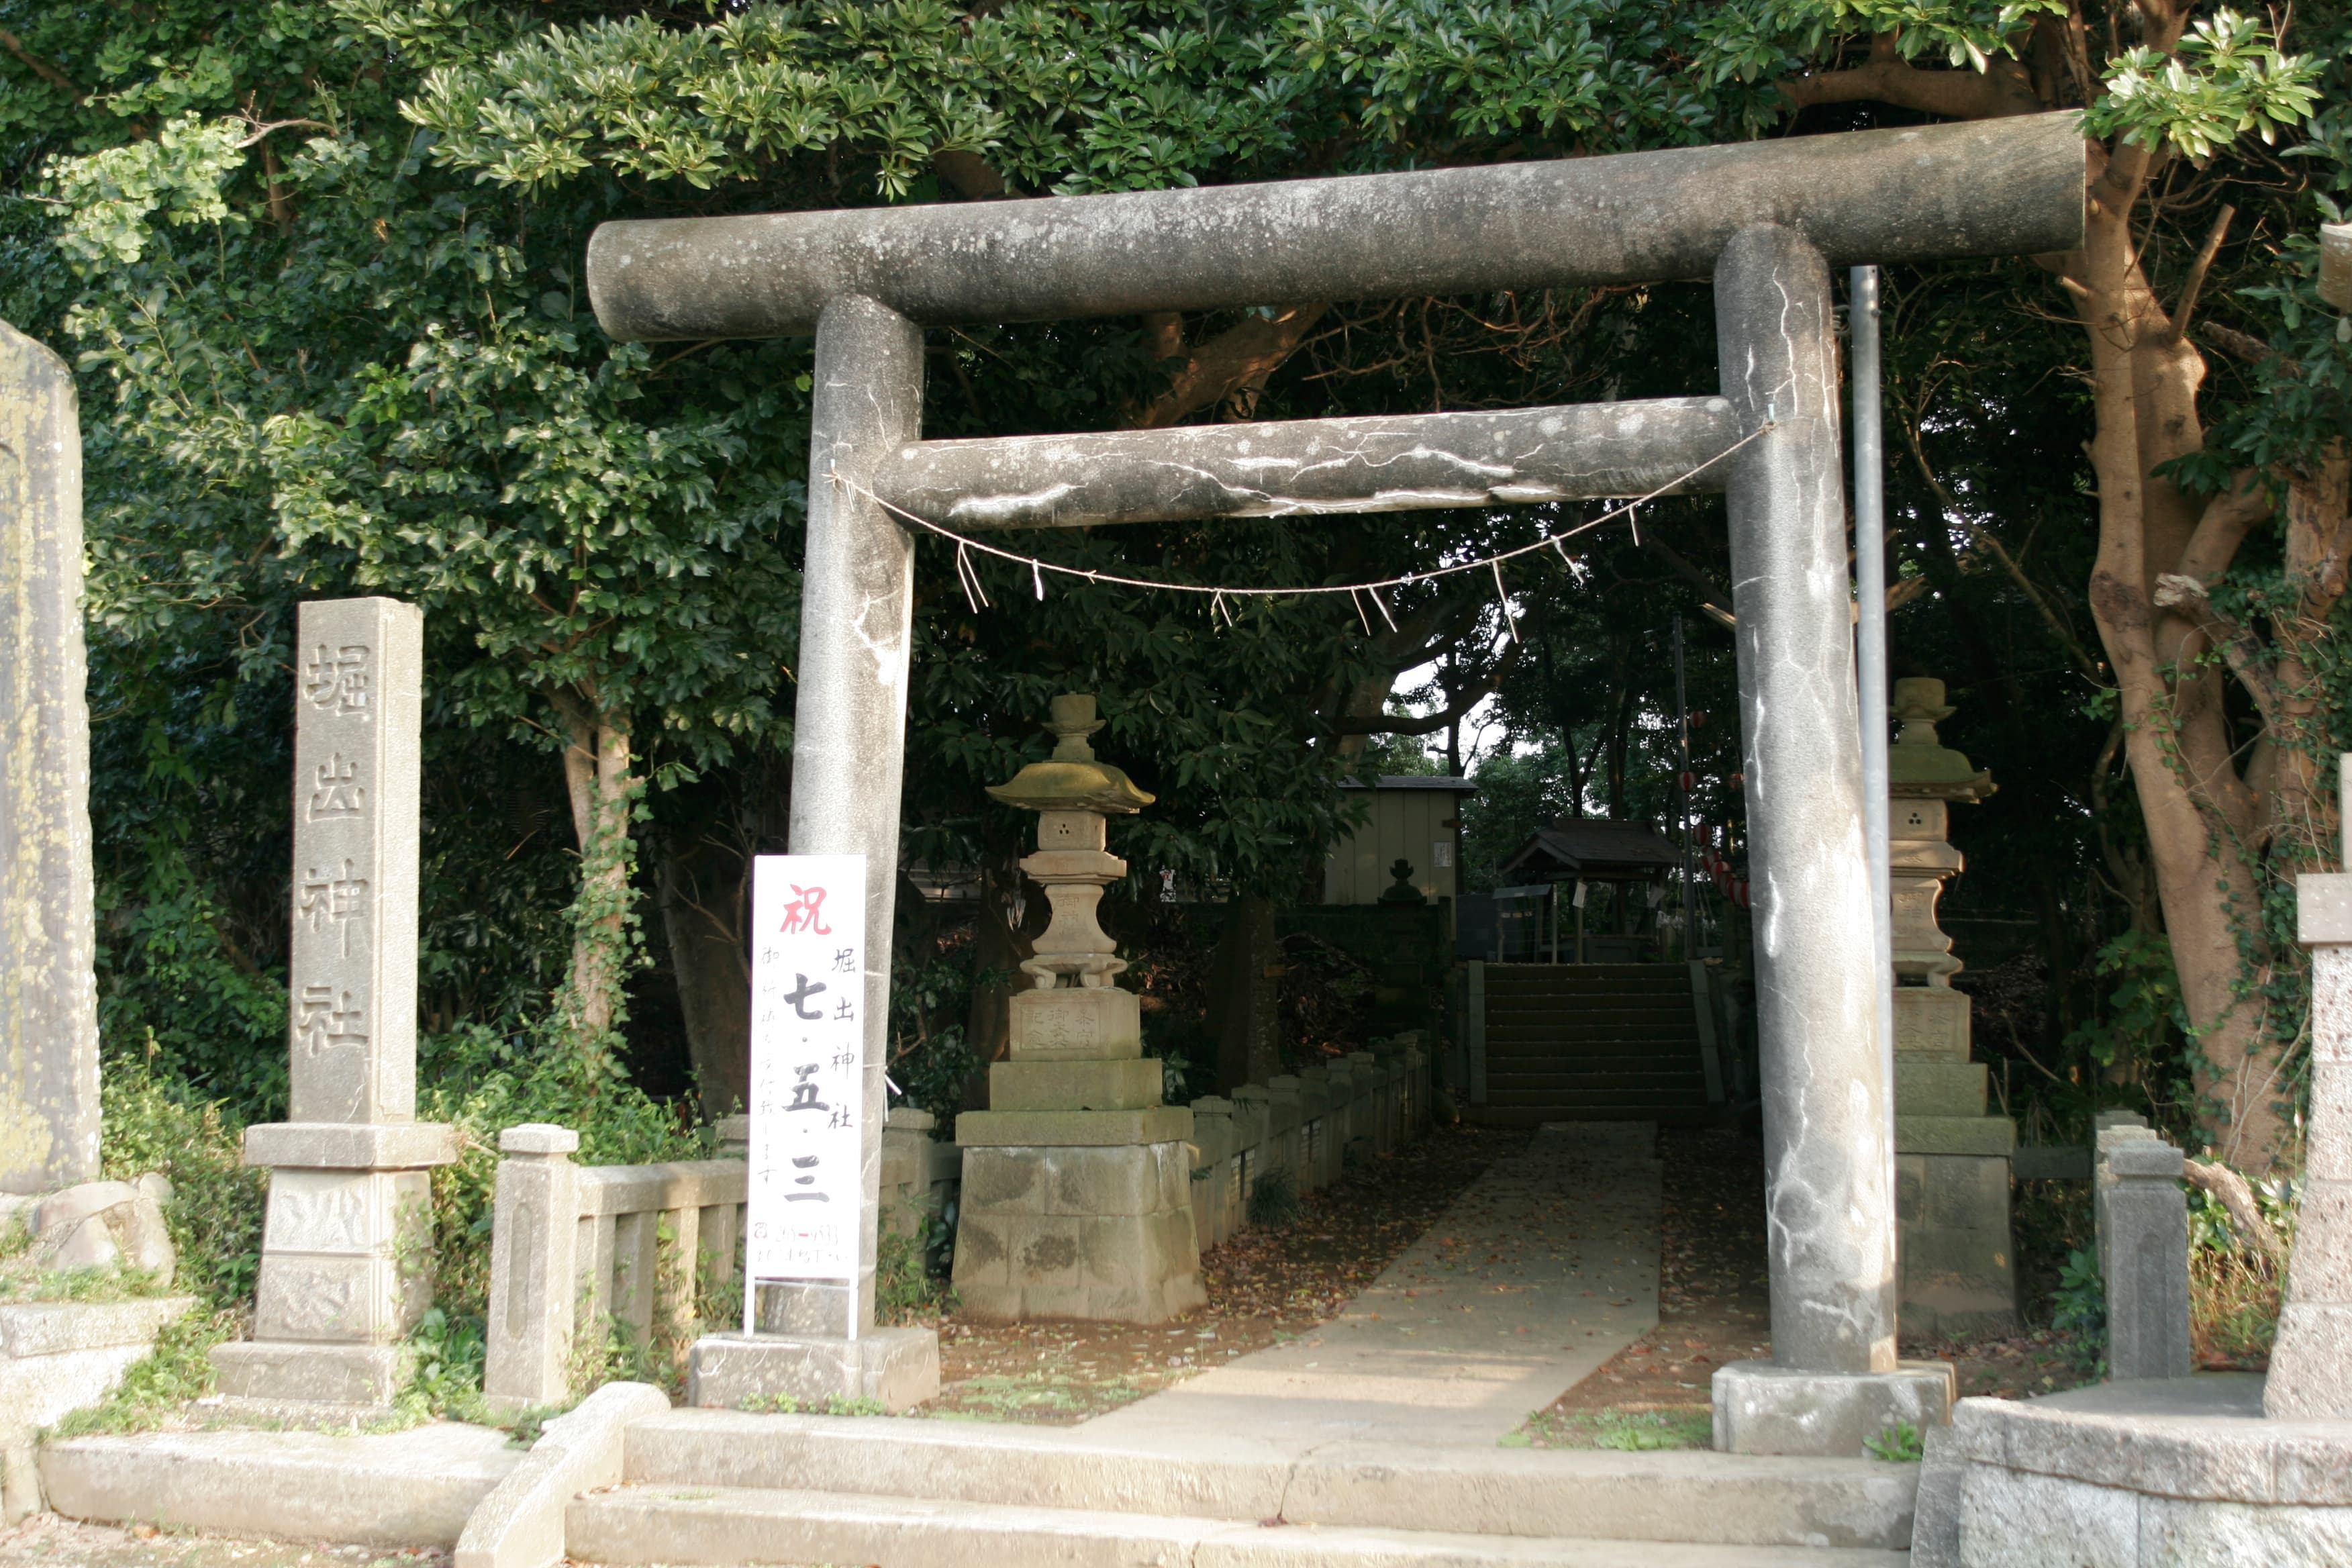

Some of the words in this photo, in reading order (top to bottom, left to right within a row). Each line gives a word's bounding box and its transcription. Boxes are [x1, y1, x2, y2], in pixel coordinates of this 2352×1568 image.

[296, 643, 371, 1057] 堀出神社
[780, 883, 832, 935] 祝
[828, 947, 856, 1129] 堀出神社
